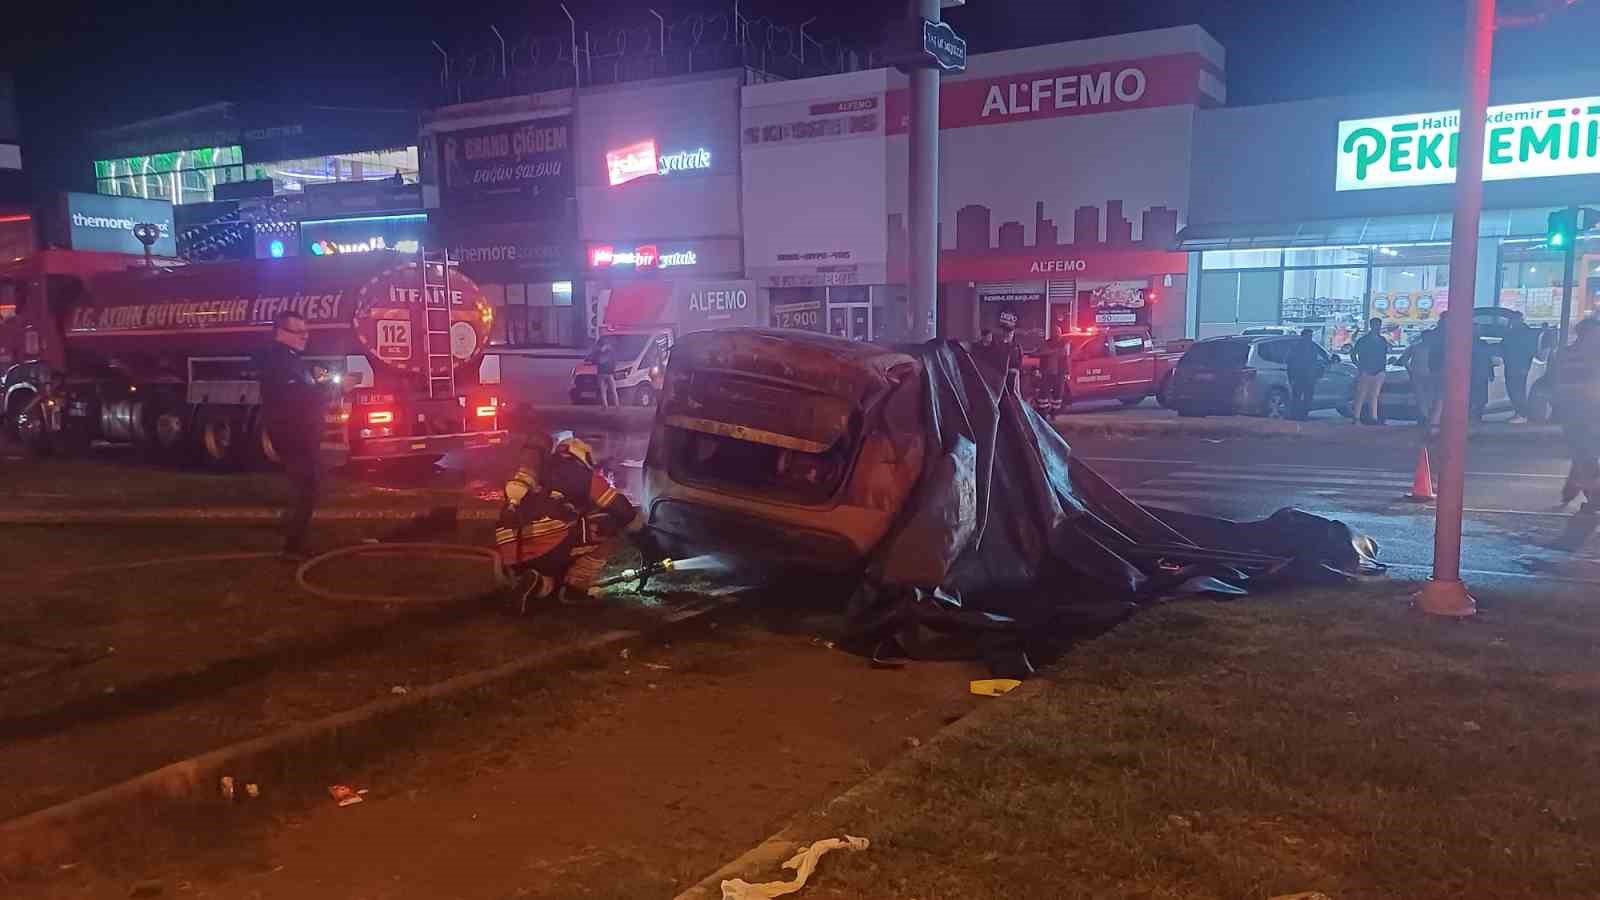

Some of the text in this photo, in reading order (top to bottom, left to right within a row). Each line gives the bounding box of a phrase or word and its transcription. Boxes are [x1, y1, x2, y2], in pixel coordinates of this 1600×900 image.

[981, 68, 1146, 117] ALFEMO
[1422, 108, 1543, 130] Halil kdemir
[1343, 107, 1600, 180] PEKEMİ
[1030, 260, 1086, 273] ALFEMO
[689, 290, 747, 311] ALFEMO
[382, 325, 406, 343] 112
